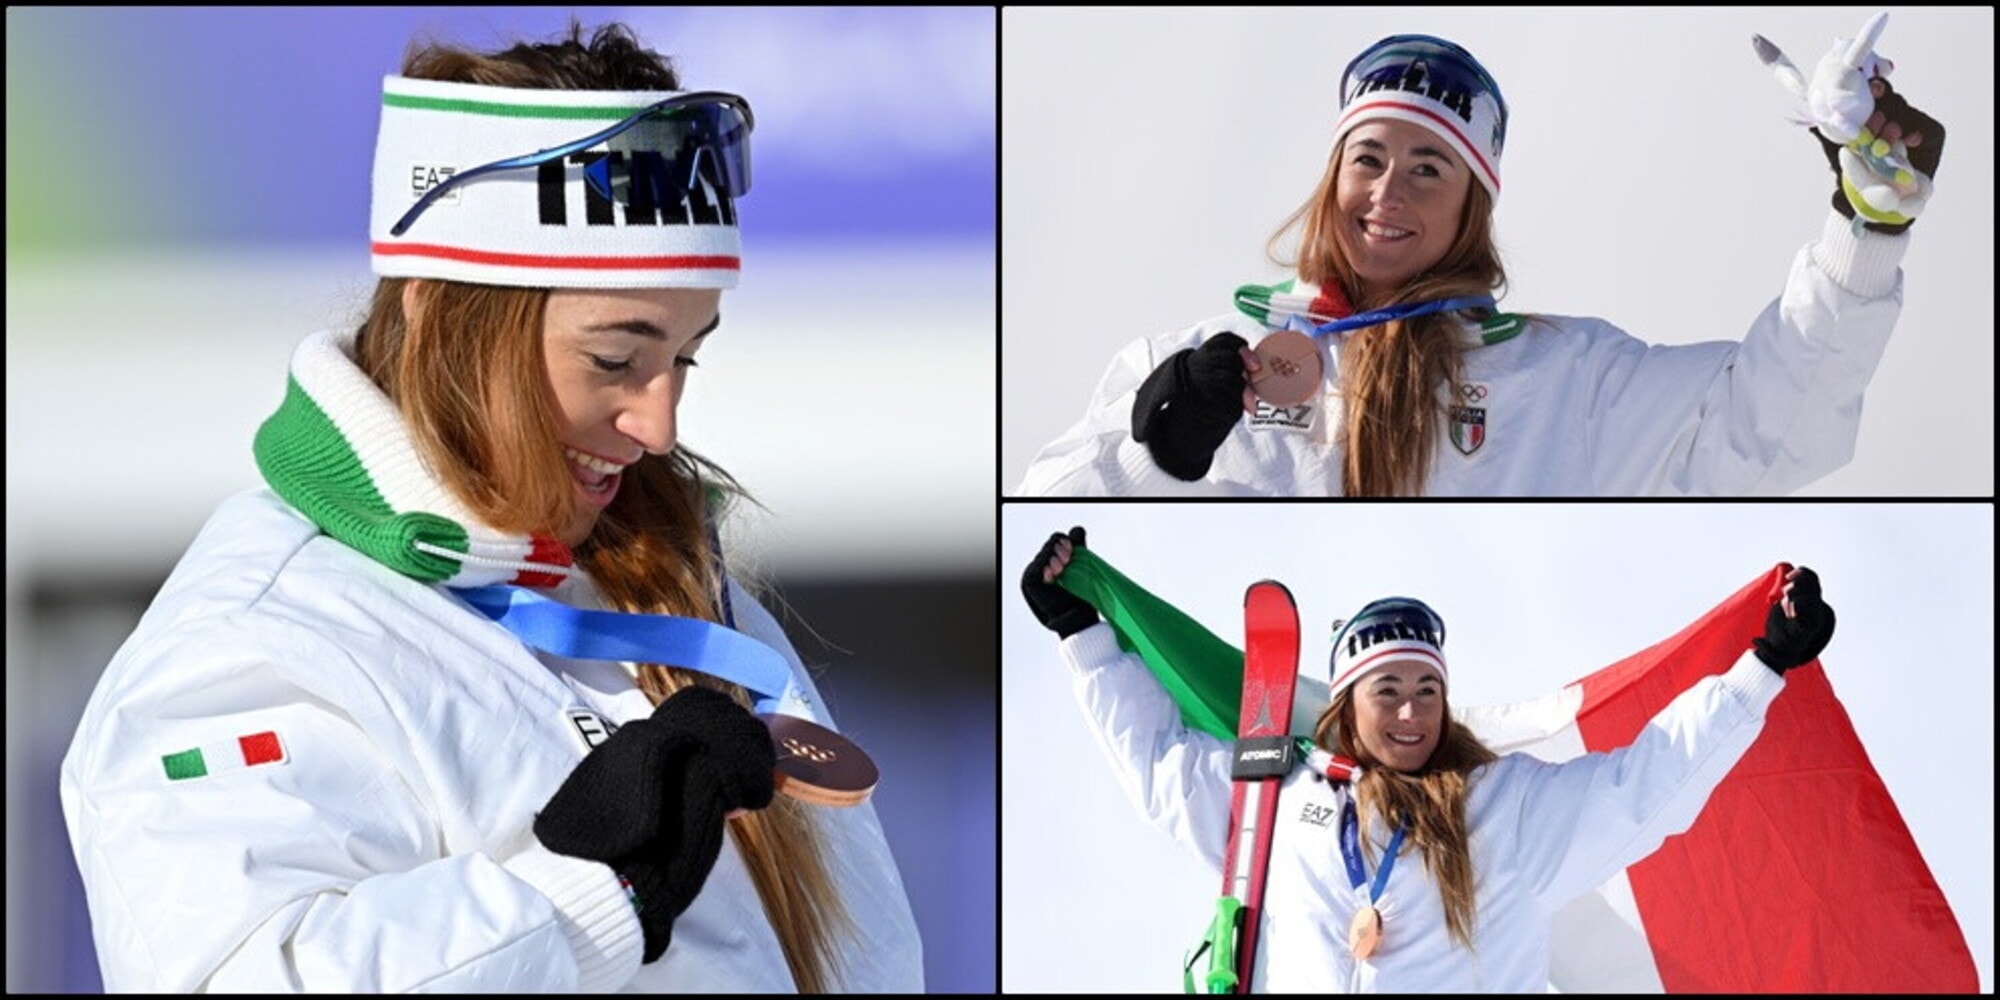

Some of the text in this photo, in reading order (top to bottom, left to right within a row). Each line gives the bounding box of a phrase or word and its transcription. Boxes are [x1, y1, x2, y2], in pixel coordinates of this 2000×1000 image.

[1348, 620, 1440, 658] ITALIA
[1240, 749, 1282, 761] ATOMIC
[1302, 802, 1334, 821] EA7
